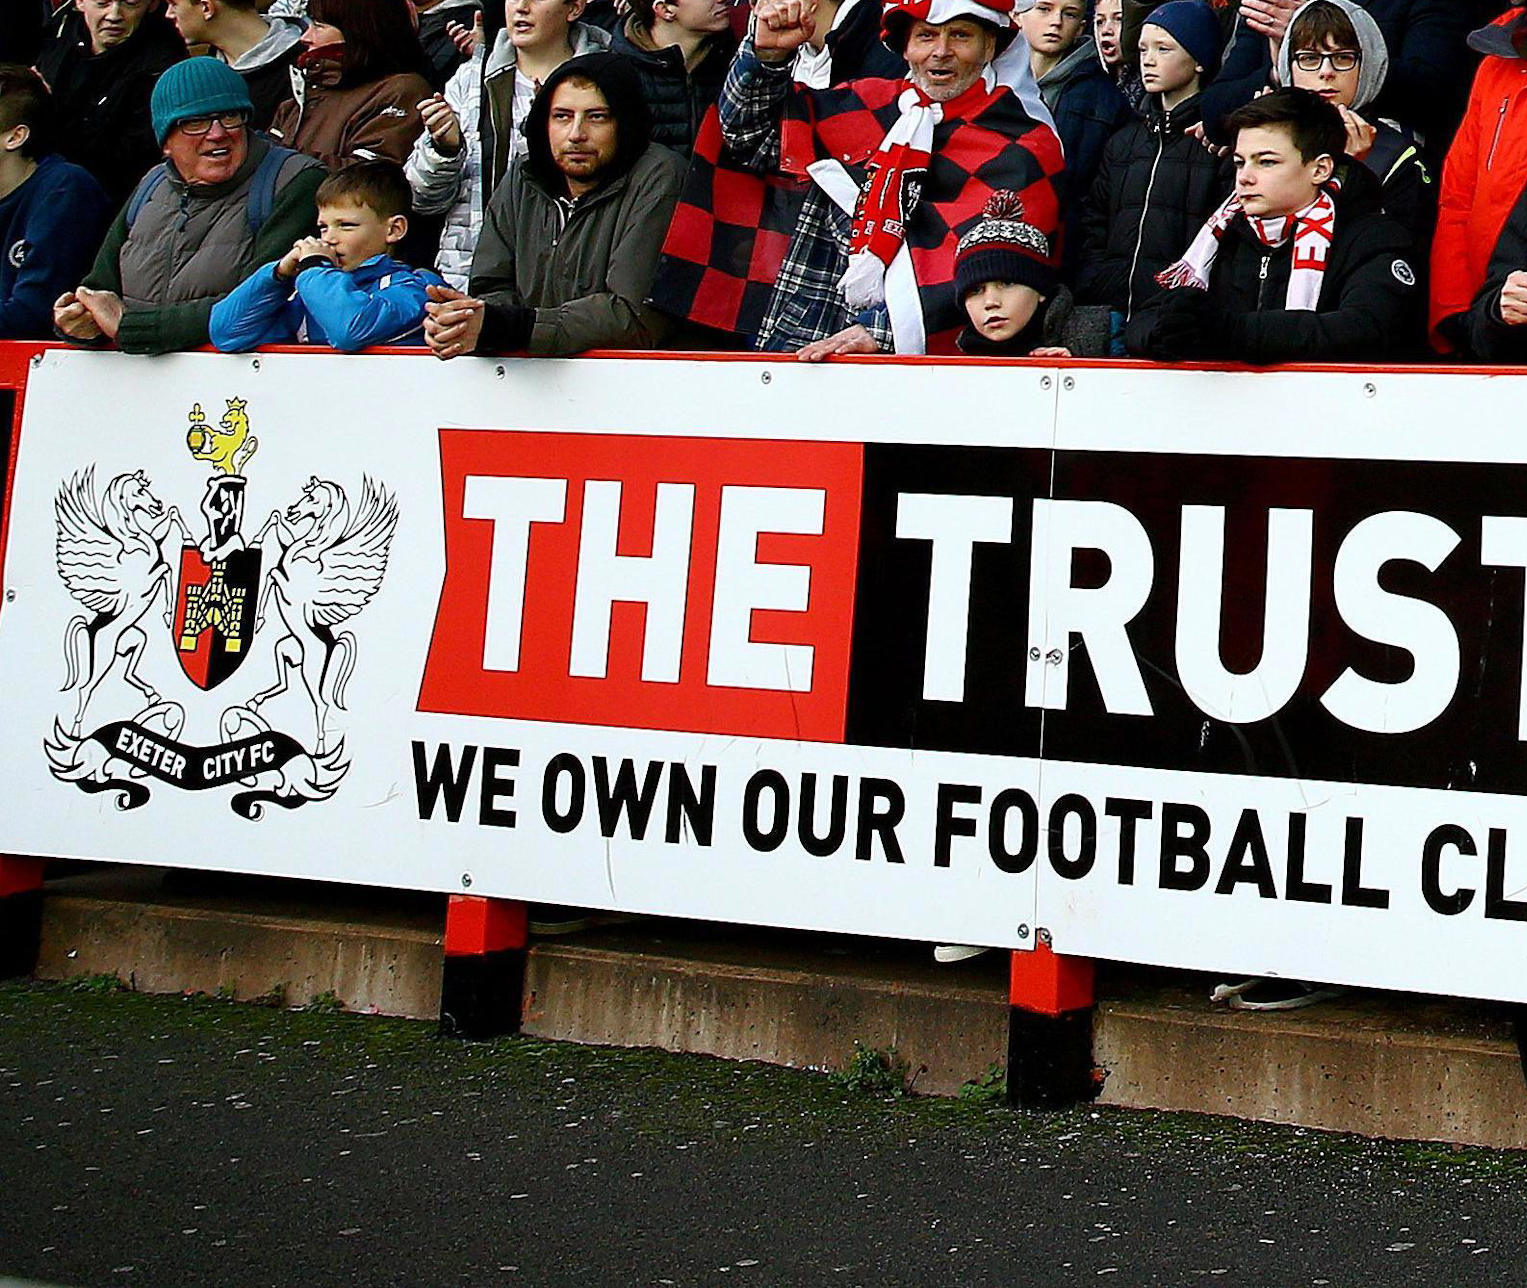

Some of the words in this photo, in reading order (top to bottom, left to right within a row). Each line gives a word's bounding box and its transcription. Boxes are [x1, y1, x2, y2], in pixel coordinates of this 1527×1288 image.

[463, 474, 827, 693] THE
[115, 727, 187, 779] EXETER
[202, 747, 247, 780] CITY
[250, 741, 275, 768] FC
[411, 739, 521, 828] WE
[541, 751, 718, 847] OWN
[742, 767, 905, 865] OUR
[933, 783, 1390, 909] FOOTBALL
